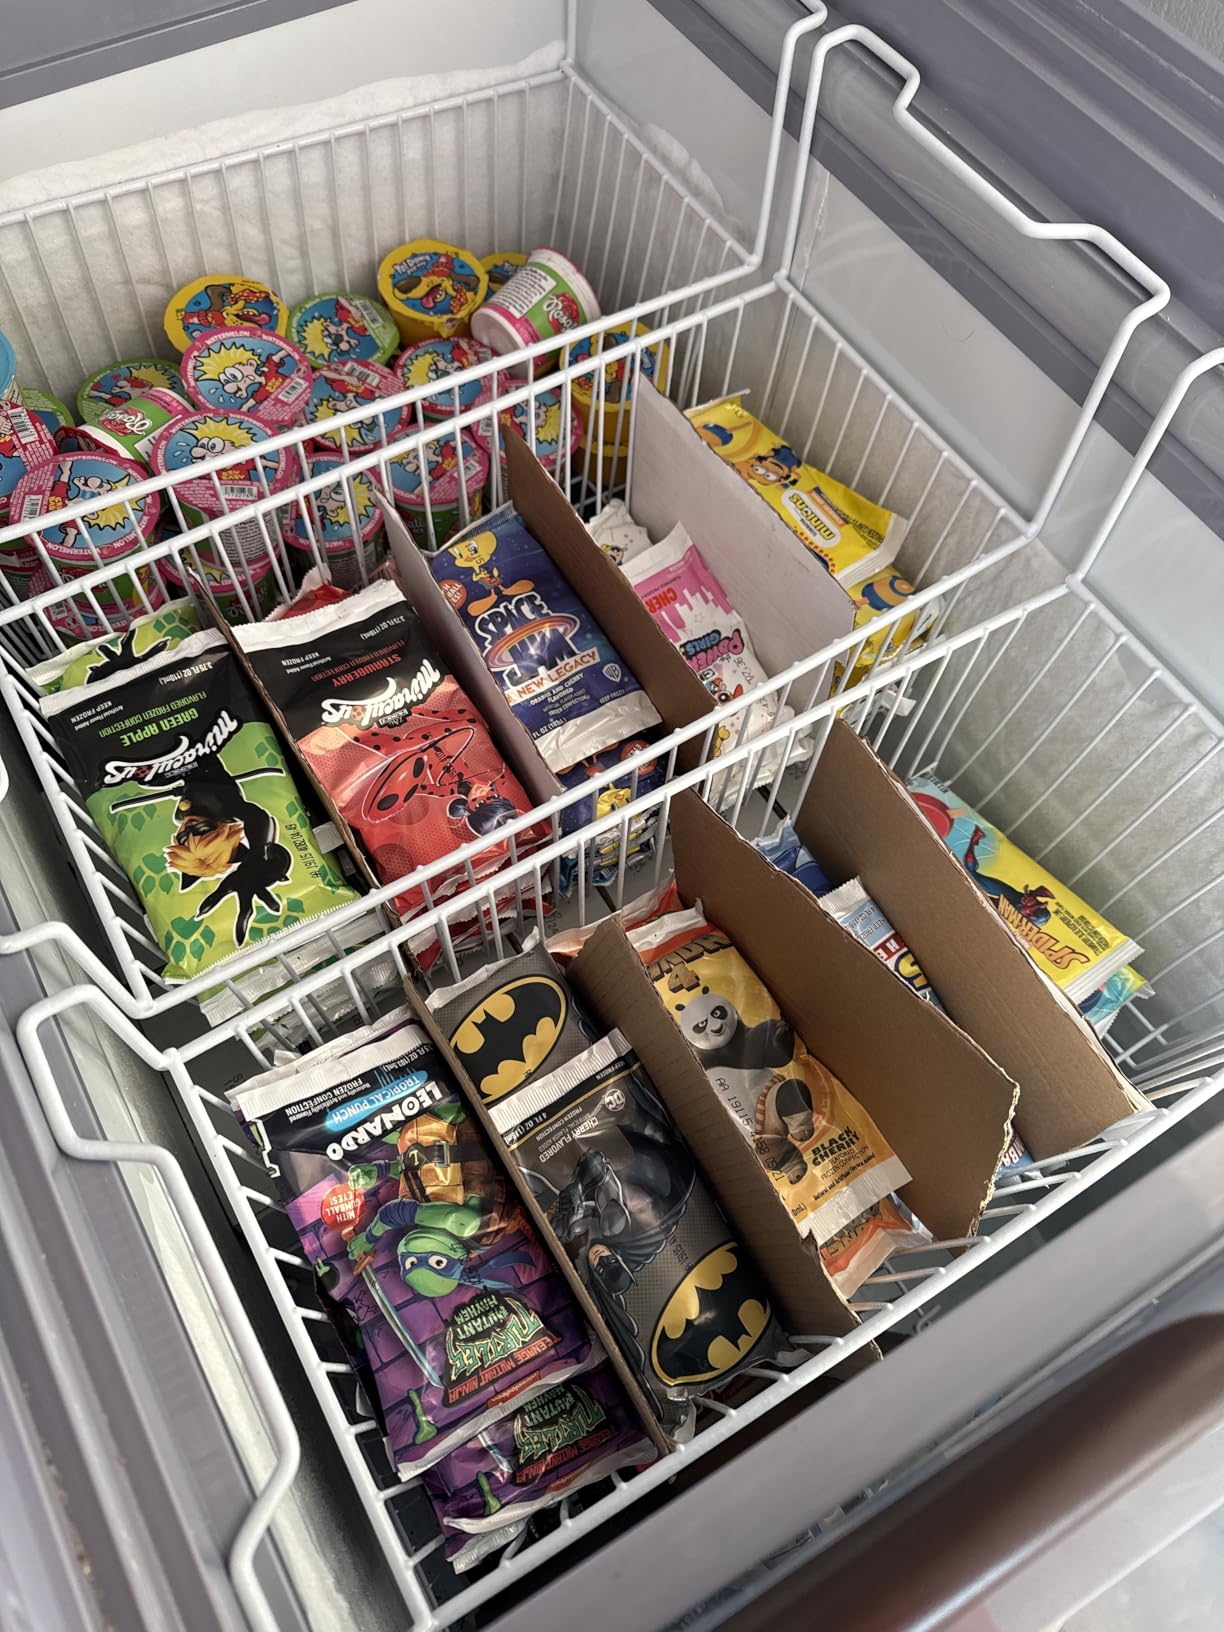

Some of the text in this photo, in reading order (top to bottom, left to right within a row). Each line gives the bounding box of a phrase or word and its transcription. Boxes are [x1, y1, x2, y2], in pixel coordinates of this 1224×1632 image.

[204, 330, 250, 346] WATERMELON
[262, 334, 300, 360] WATERMELON
[169, 412, 214, 433] WATERMELON
[229, 412, 272, 435] WATERMELON
[65, 455, 118, 464] WATERMELON
[645, 587, 678, 614] CHER
[476, 592, 552, 640] SPACE
[685, 631, 721, 656] GIRLS
[686, 628, 743, 672] POWER
[192, 666, 200, 675] FL
[198, 662, 214, 672] 3.75
[281, 652, 320, 666] KEEP FROZEN
[332, 653, 402, 688] STRAWBERRY
[183, 668, 192, 678] OZ
[516, 651, 596, 698] NEW LEGACY
[552, 686, 564, 696] AND
[564, 672, 584, 688] CHERRY
[548, 688, 574, 703] FLAVORED
[71, 700, 112, 724] KEEP FROZEN
[98, 691, 207, 738] FLAVORED FROZEN CONFECTION
[120, 708, 200, 747] GREEN APPLE
[857, 926, 874, 940] FROZE
[596, 1066, 615, 1080] FROZEN
[285, 1076, 364, 1117] FROZEN CONFECTION
[332, 1076, 420, 1124] TROPICAL PUNCH
[338, 1090, 348, 1099] and
[348, 1082, 372, 1096] Naturally
[606, 1092, 624, 1108] DC
[716, 1078, 730, 1092] AA
[728, 1096, 754, 1126] 19115
[289, 1107, 312, 1124] Flavored
[326, 1080, 443, 1160] LEONARDO
[525, 1120, 534, 1130] OZ
[534, 1114, 542, 1123] FL
[535, 1106, 582, 1142] FROZEN CONFECTION
[539, 1117, 598, 1163] CHERRY FLAVORED
[811, 1126, 852, 1156] BLACK
[812, 1131, 860, 1166] CHERRY
[408, 1149, 418, 1165] L
[821, 1144, 869, 1180] FROZEN CONFECTION
[831, 1148, 855, 1166] FLAVORED
[828, 1181, 836, 1190] and
[325, 1198, 360, 1217] GUMBALL
[330, 1191, 353, 1206] EYES!
[336, 1210, 356, 1224] WITH
[454, 1295, 498, 1325] MAYHEM
[456, 1305, 509, 1340] MUTANT
[446, 1297, 544, 1381] TURTLES
[448, 1336, 562, 1404] TEENAGE MUTANT NINJA
[524, 1392, 576, 1427] MUTANT
[514, 1384, 606, 1464] TURTLES
